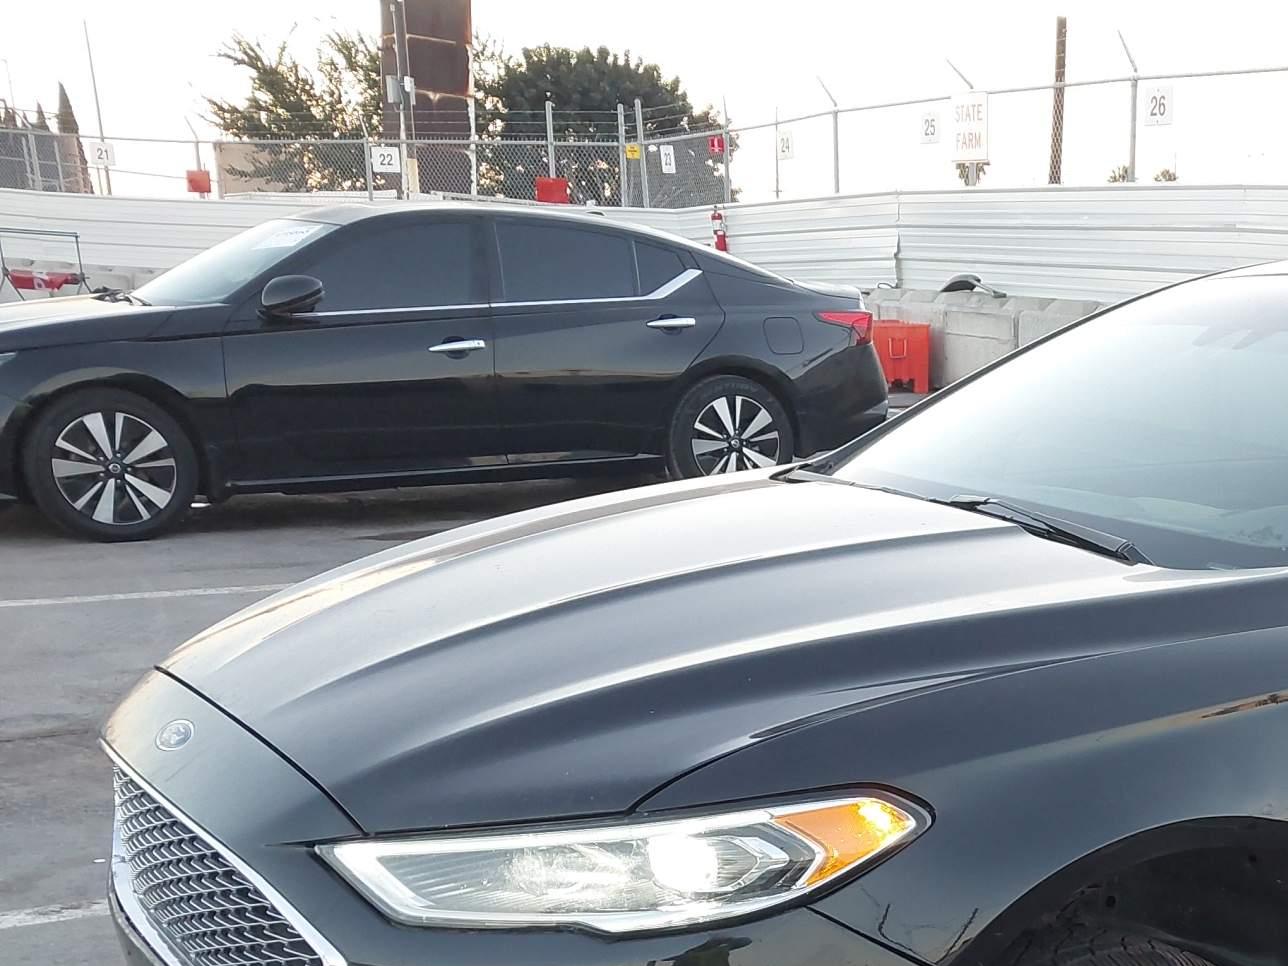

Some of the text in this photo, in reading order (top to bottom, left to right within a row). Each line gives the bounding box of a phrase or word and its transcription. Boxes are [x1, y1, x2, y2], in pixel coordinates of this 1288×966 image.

[954, 104, 983, 123] STATE
[1150, 95, 1167, 117] 26
[924, 118, 936, 136] 25
[781, 138, 791, 153] 24
[955, 132, 982, 151] FARM
[96, 148, 110, 161] 21
[379, 153, 394, 167] 22
[663, 152, 672, 166] 23
